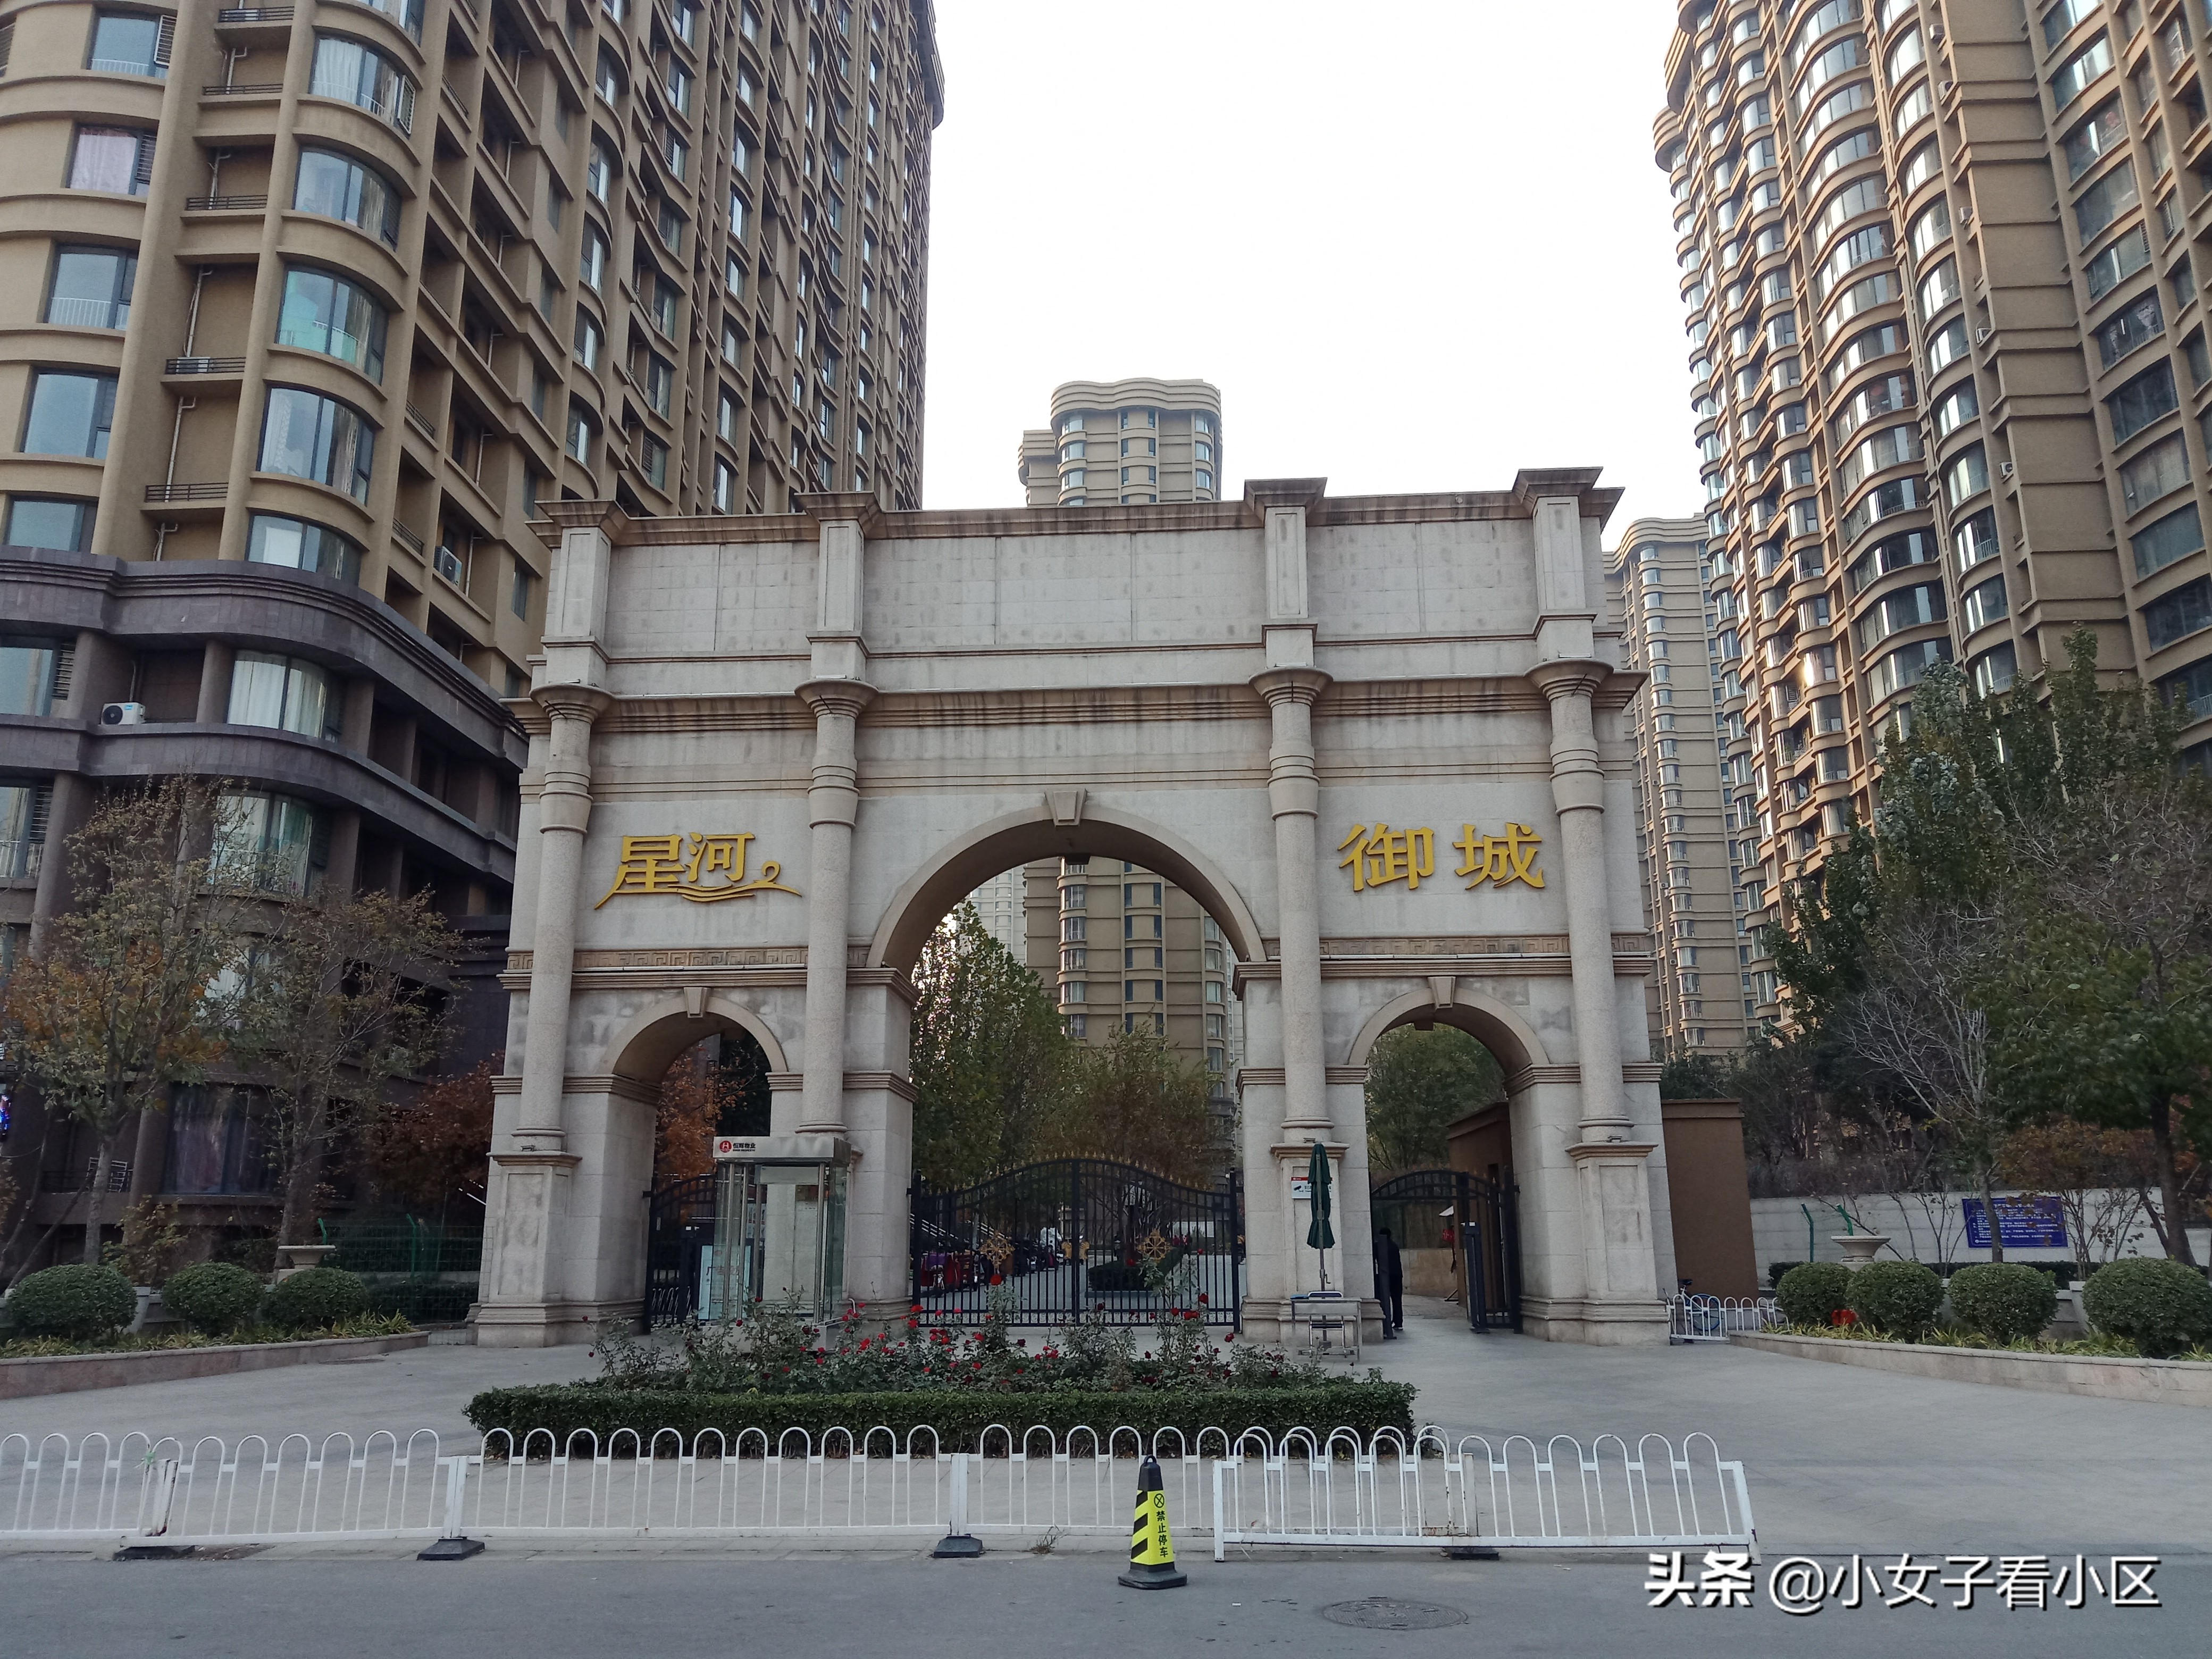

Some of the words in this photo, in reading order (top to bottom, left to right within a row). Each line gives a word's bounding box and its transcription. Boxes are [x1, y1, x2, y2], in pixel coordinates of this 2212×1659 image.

[594, 832, 756, 910] 星河
[1337, 822, 1545, 892] 御城
[1156, 1510, 1168, 1558] 禁止停车
